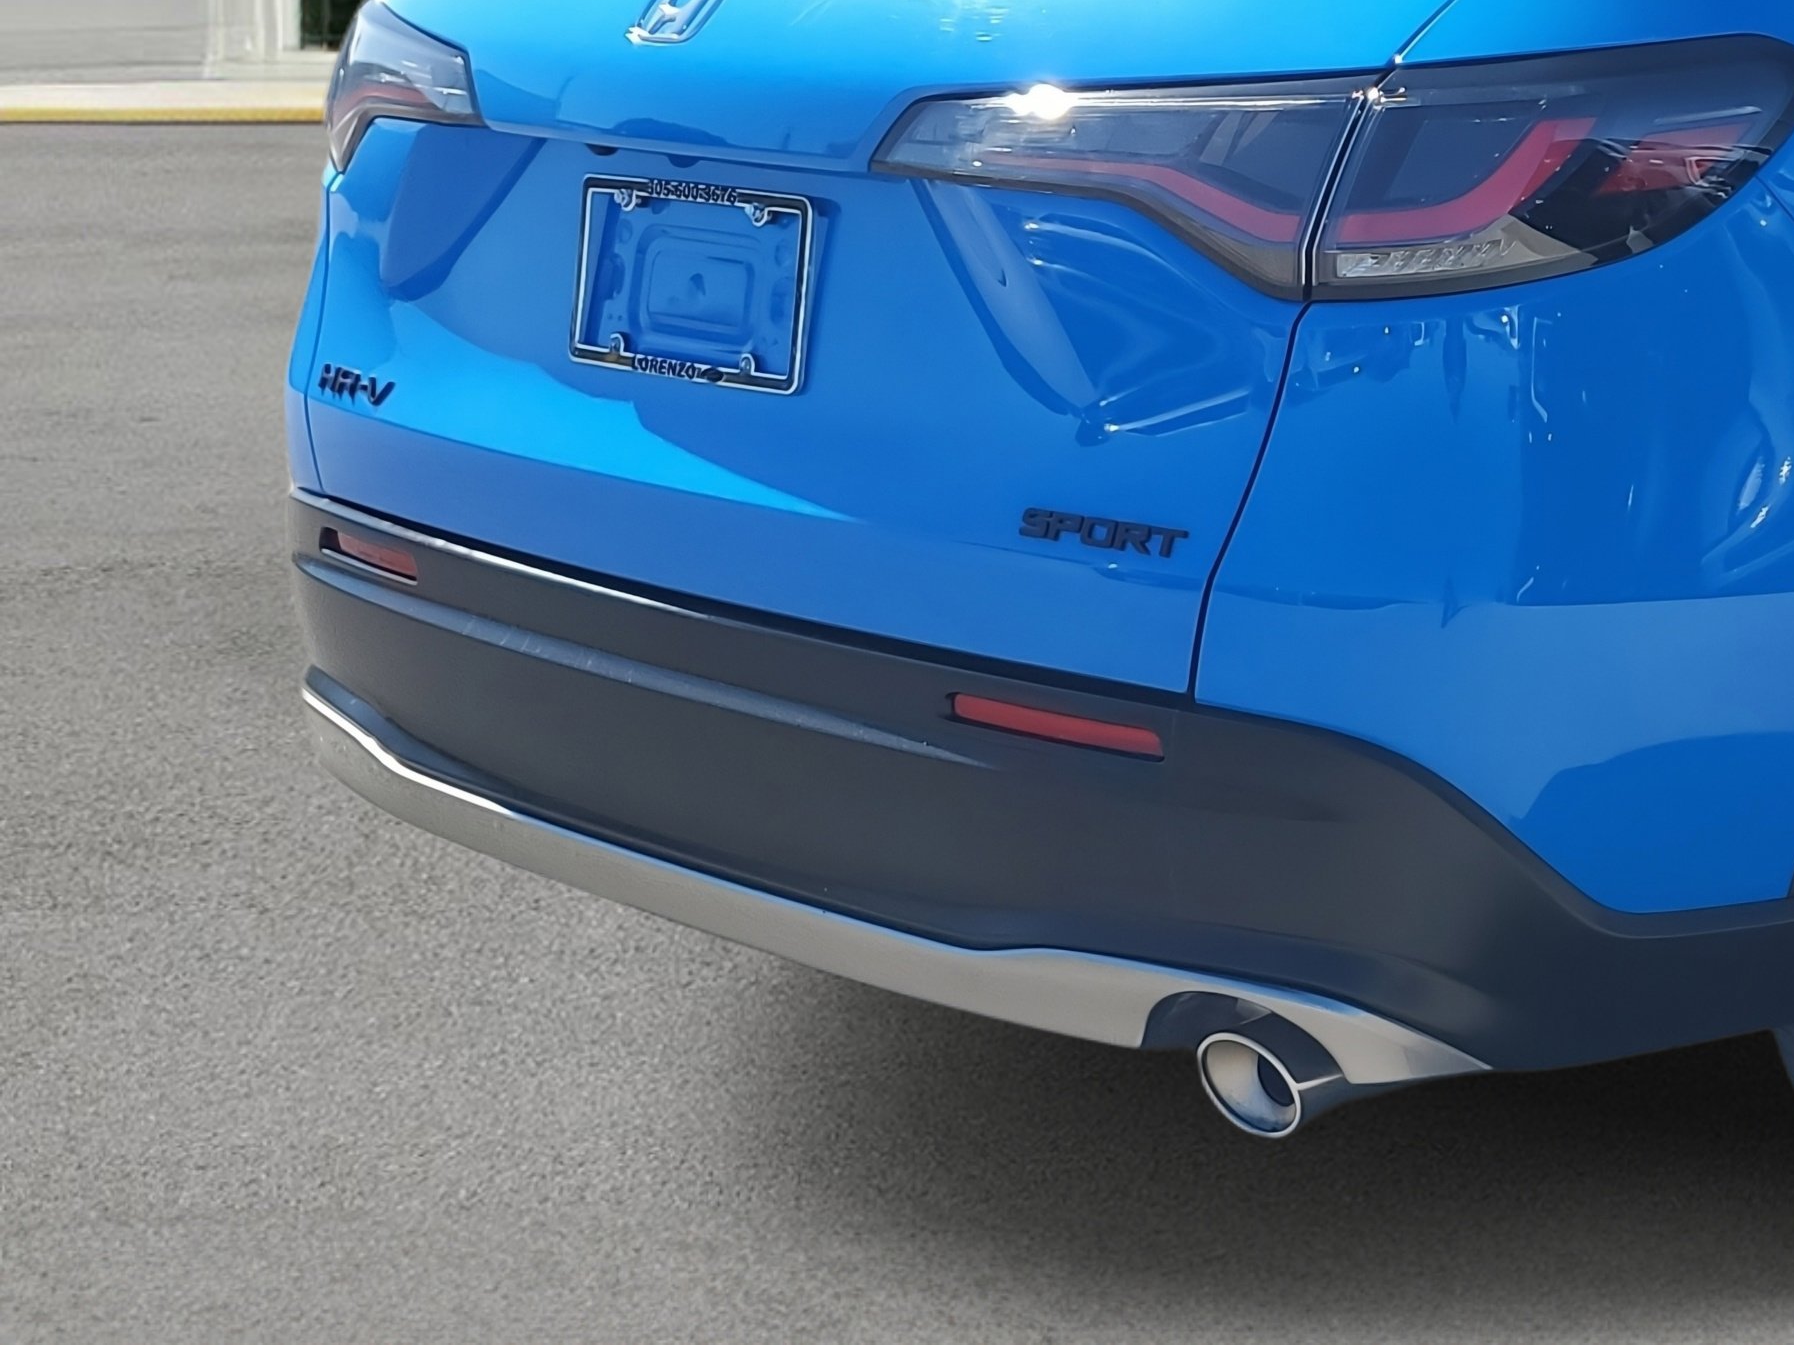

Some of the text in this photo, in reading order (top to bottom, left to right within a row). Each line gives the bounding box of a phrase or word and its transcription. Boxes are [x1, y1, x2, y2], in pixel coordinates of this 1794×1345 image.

[318, 363, 396, 407] HR-V
[632, 355, 697, 380] LORENZO
[1019, 507, 1189, 558] SPORT
